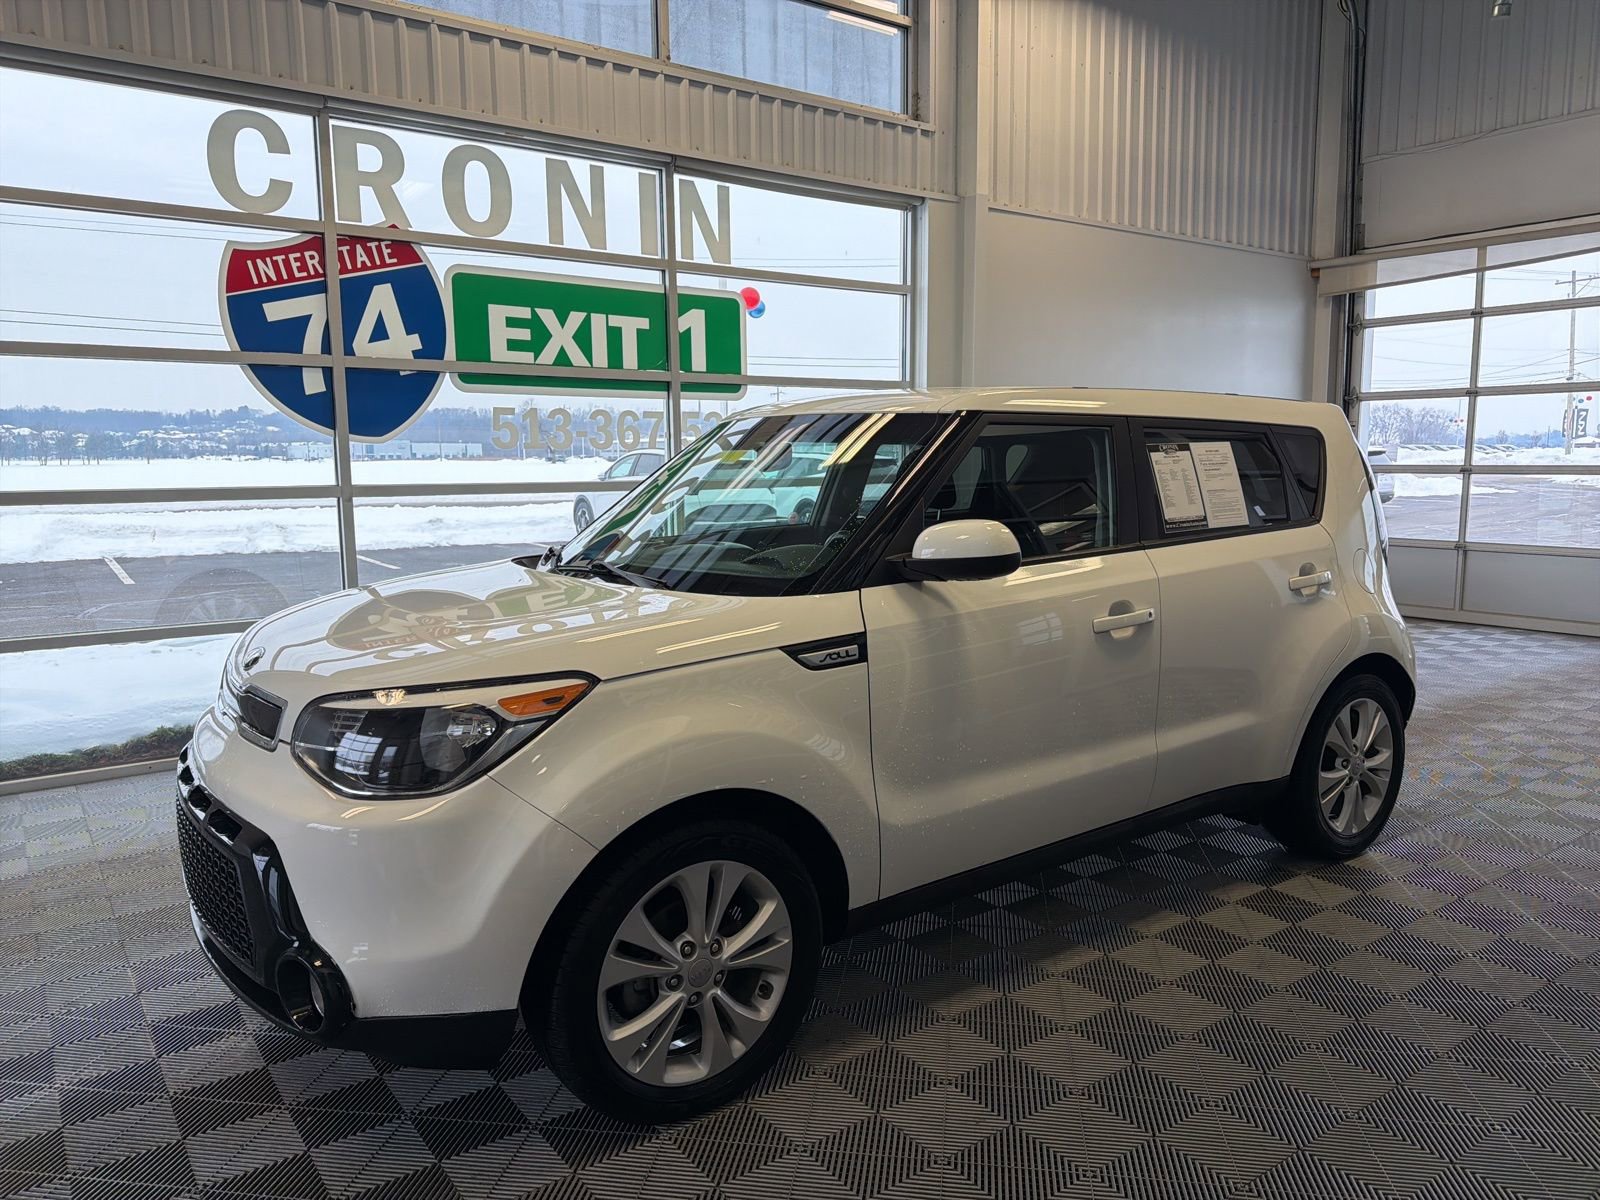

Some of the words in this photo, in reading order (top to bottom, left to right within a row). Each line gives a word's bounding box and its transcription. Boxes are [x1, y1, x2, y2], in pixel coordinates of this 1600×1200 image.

[206, 109, 731, 265] CRONIN
[246, 240, 398, 285] INTERTATE
[261, 283, 423, 395] 74
[487, 303, 650, 370] EXIT
[676, 308, 707, 372] 1
[819, 649, 857, 663] SOUL
